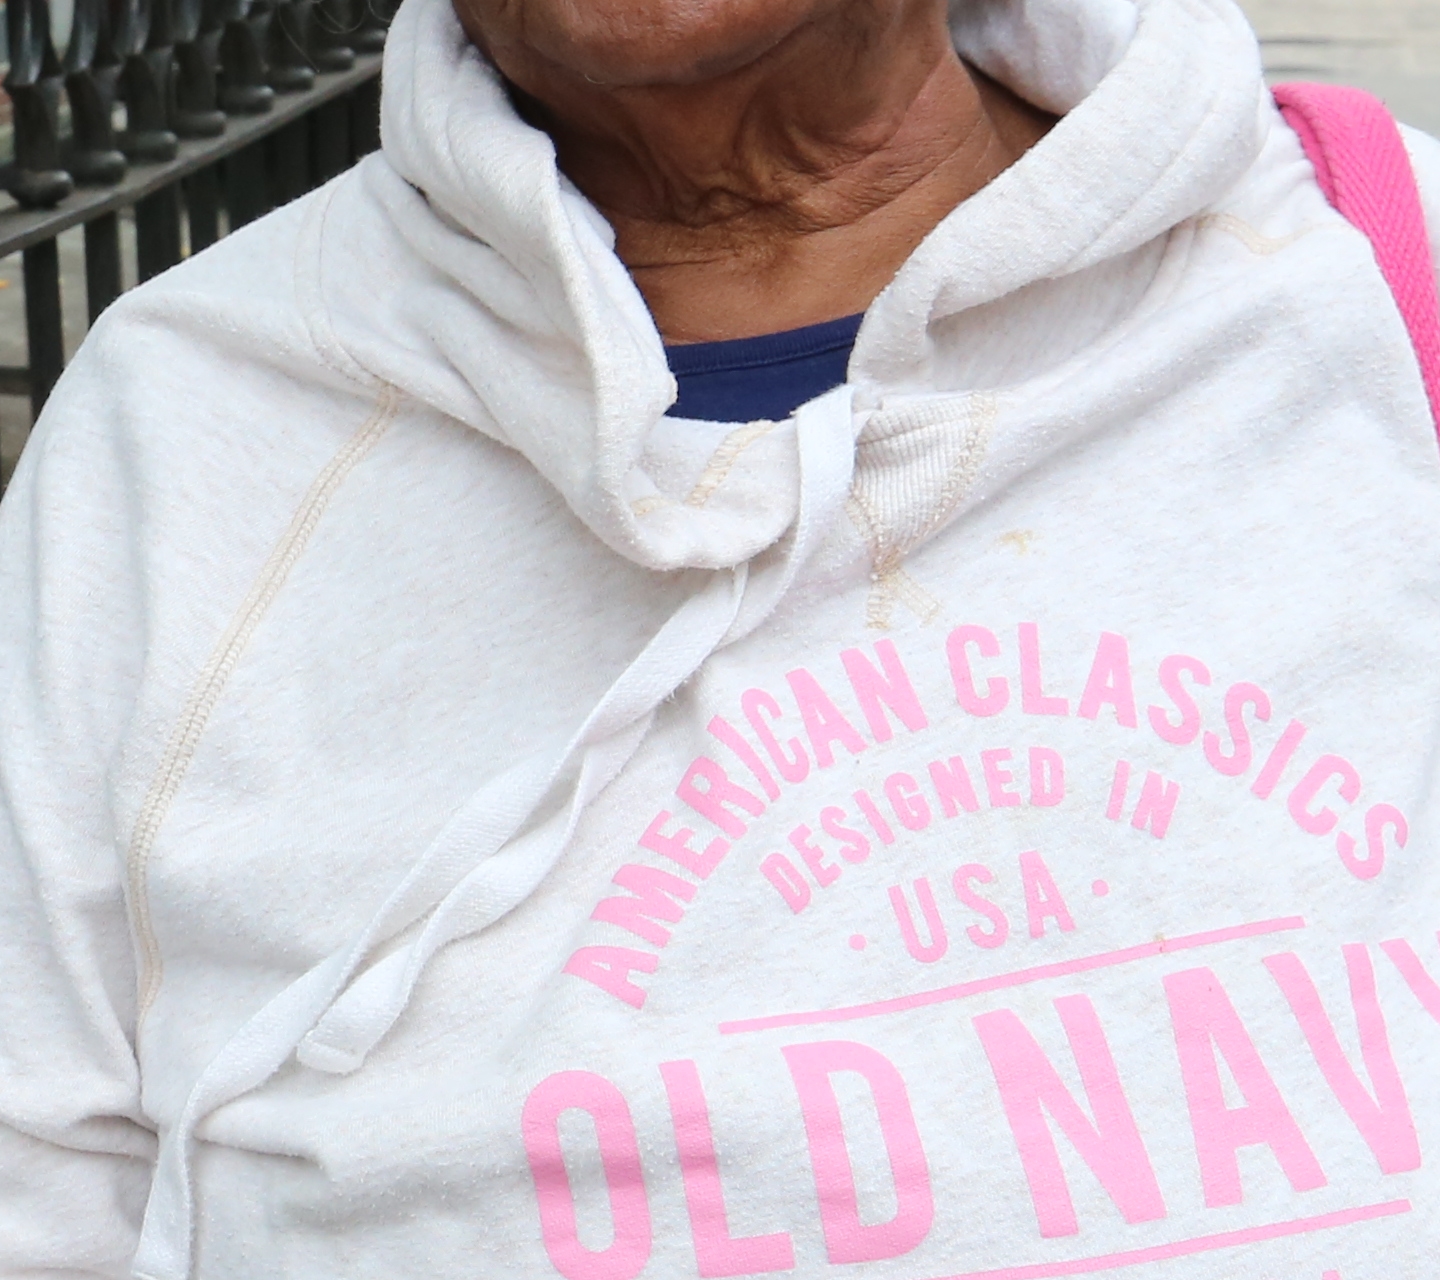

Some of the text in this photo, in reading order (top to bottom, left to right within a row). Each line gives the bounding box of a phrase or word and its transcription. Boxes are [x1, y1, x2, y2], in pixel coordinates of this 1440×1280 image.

[562, 621, 1410, 1010] AMERICAN CLASSICS
[759, 745, 1181, 915] DESIGNED IN
[886, 850, 1077, 965] USA
